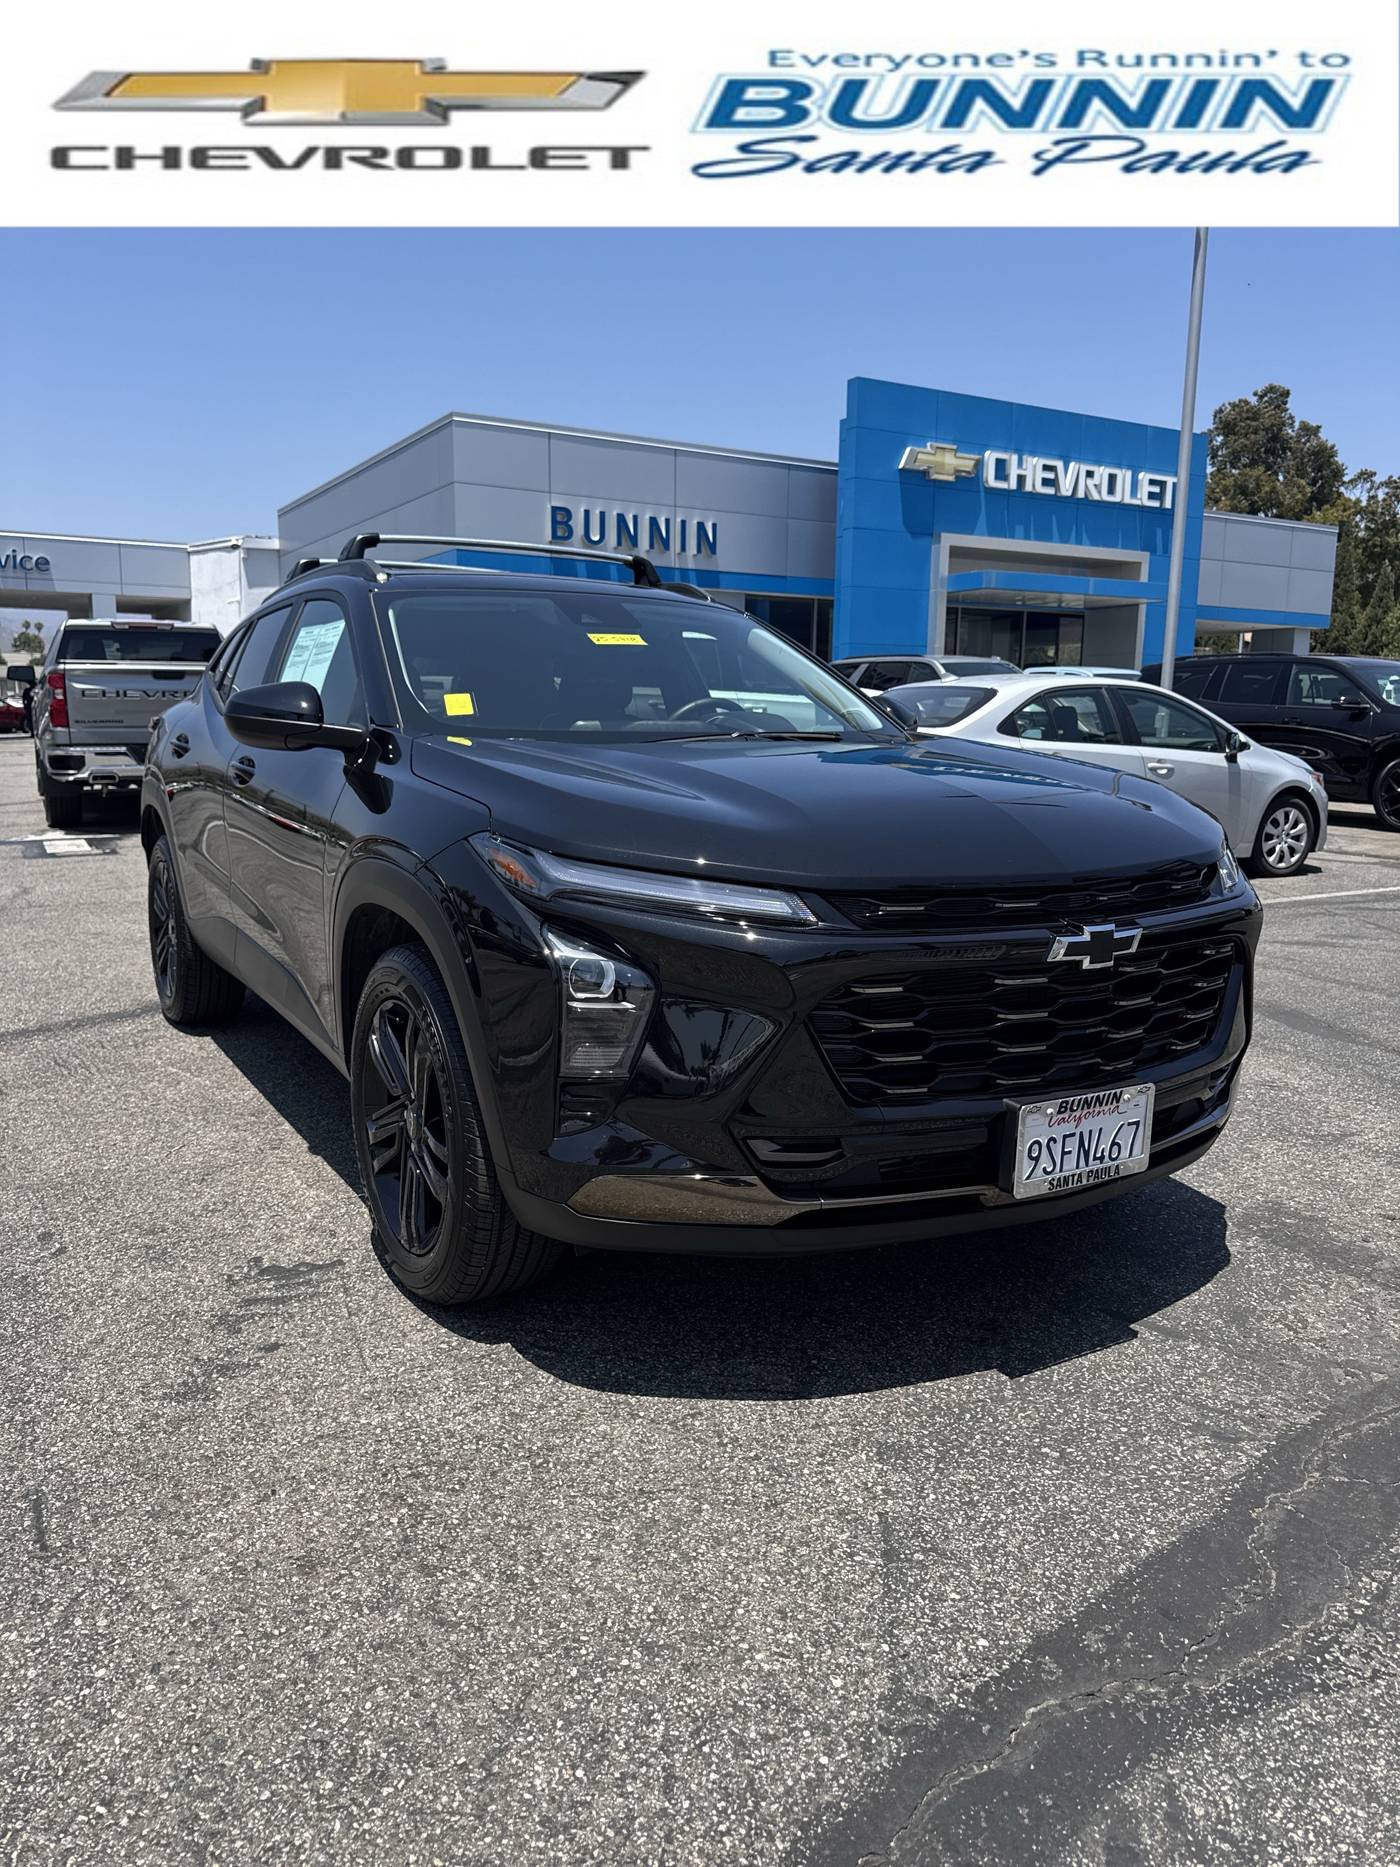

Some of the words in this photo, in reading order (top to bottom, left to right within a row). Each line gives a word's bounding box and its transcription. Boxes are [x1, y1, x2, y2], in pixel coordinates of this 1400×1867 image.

[984, 450, 1178, 509] CHEVROLET
[550, 505, 718, 556] BUNNIN
[1048, 1104, 1128, 1129] California
[1056, 1089, 1124, 1116] BUNNIN
[1024, 1119, 1141, 1182] 9SFN467
[1047, 1172, 1084, 1192] SANTA
[1086, 1163, 1121, 1183] PAULA
